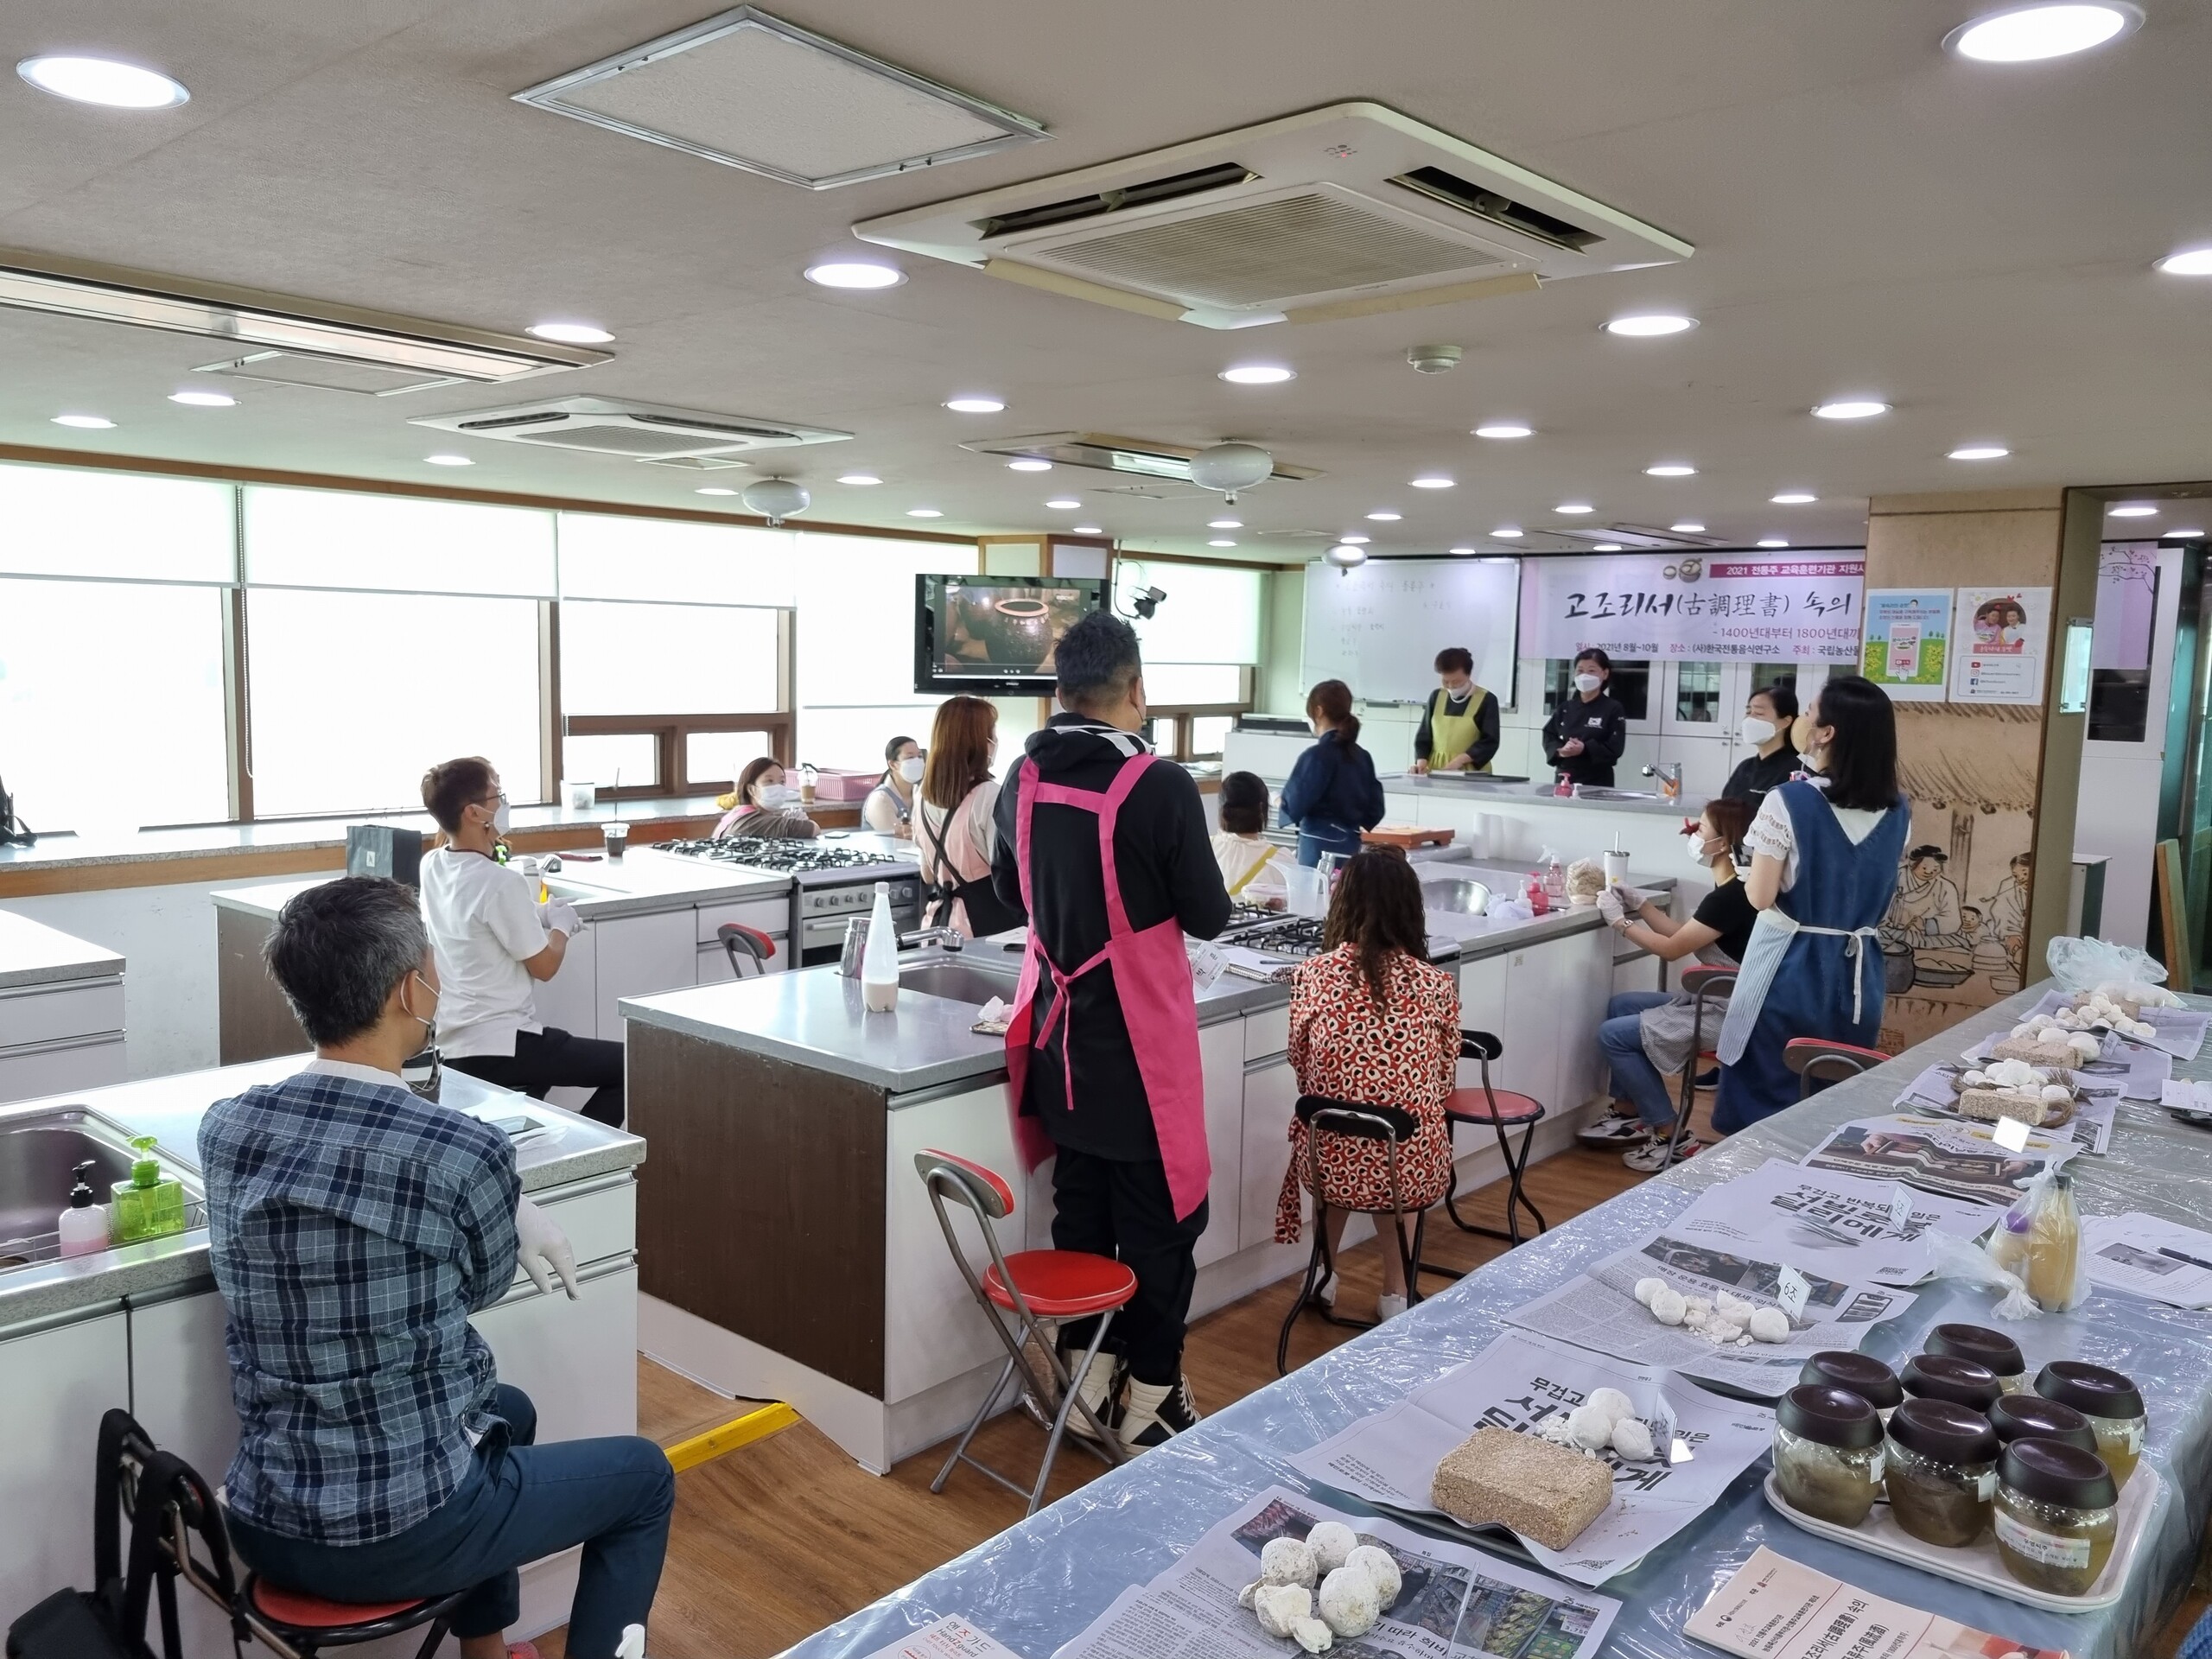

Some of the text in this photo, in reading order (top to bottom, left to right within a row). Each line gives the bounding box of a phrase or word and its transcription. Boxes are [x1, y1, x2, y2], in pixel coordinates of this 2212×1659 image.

[1726, 566, 1748, 575] 2021
[1751, 565, 1779, 575] 전통주
[1780, 564, 1837, 575] 교육훈련기관
[1564, 591, 1851, 619] 고조리서(古調理書) 속의
[1720, 627, 1793, 639] 1400년대부터
[1597, 642, 1624, 652] 2021년
[1624, 643, 1659, 652] 8월~10월
[1669, 644, 1687, 652] 장소
[1693, 643, 1780, 655] (사)한국전통음식연구소
[1792, 645, 1810, 655] 주최
[1797, 1184, 1841, 1200] 무겁고
[1846, 1197, 1891, 1213] 반복되
[1770, 1195, 1922, 1243] 딜리에게
[1784, 1282, 1797, 1303] 6조
[1529, 1376, 1586, 1408] 무겁고
[1388, 1625, 1418, 1638] 따라
[1801, 1599, 1869, 1659] 조리서(古調理書) 속의
[937, 1628, 979, 1658] HandZguard
[1748, 1637, 1759, 1648] 2021
